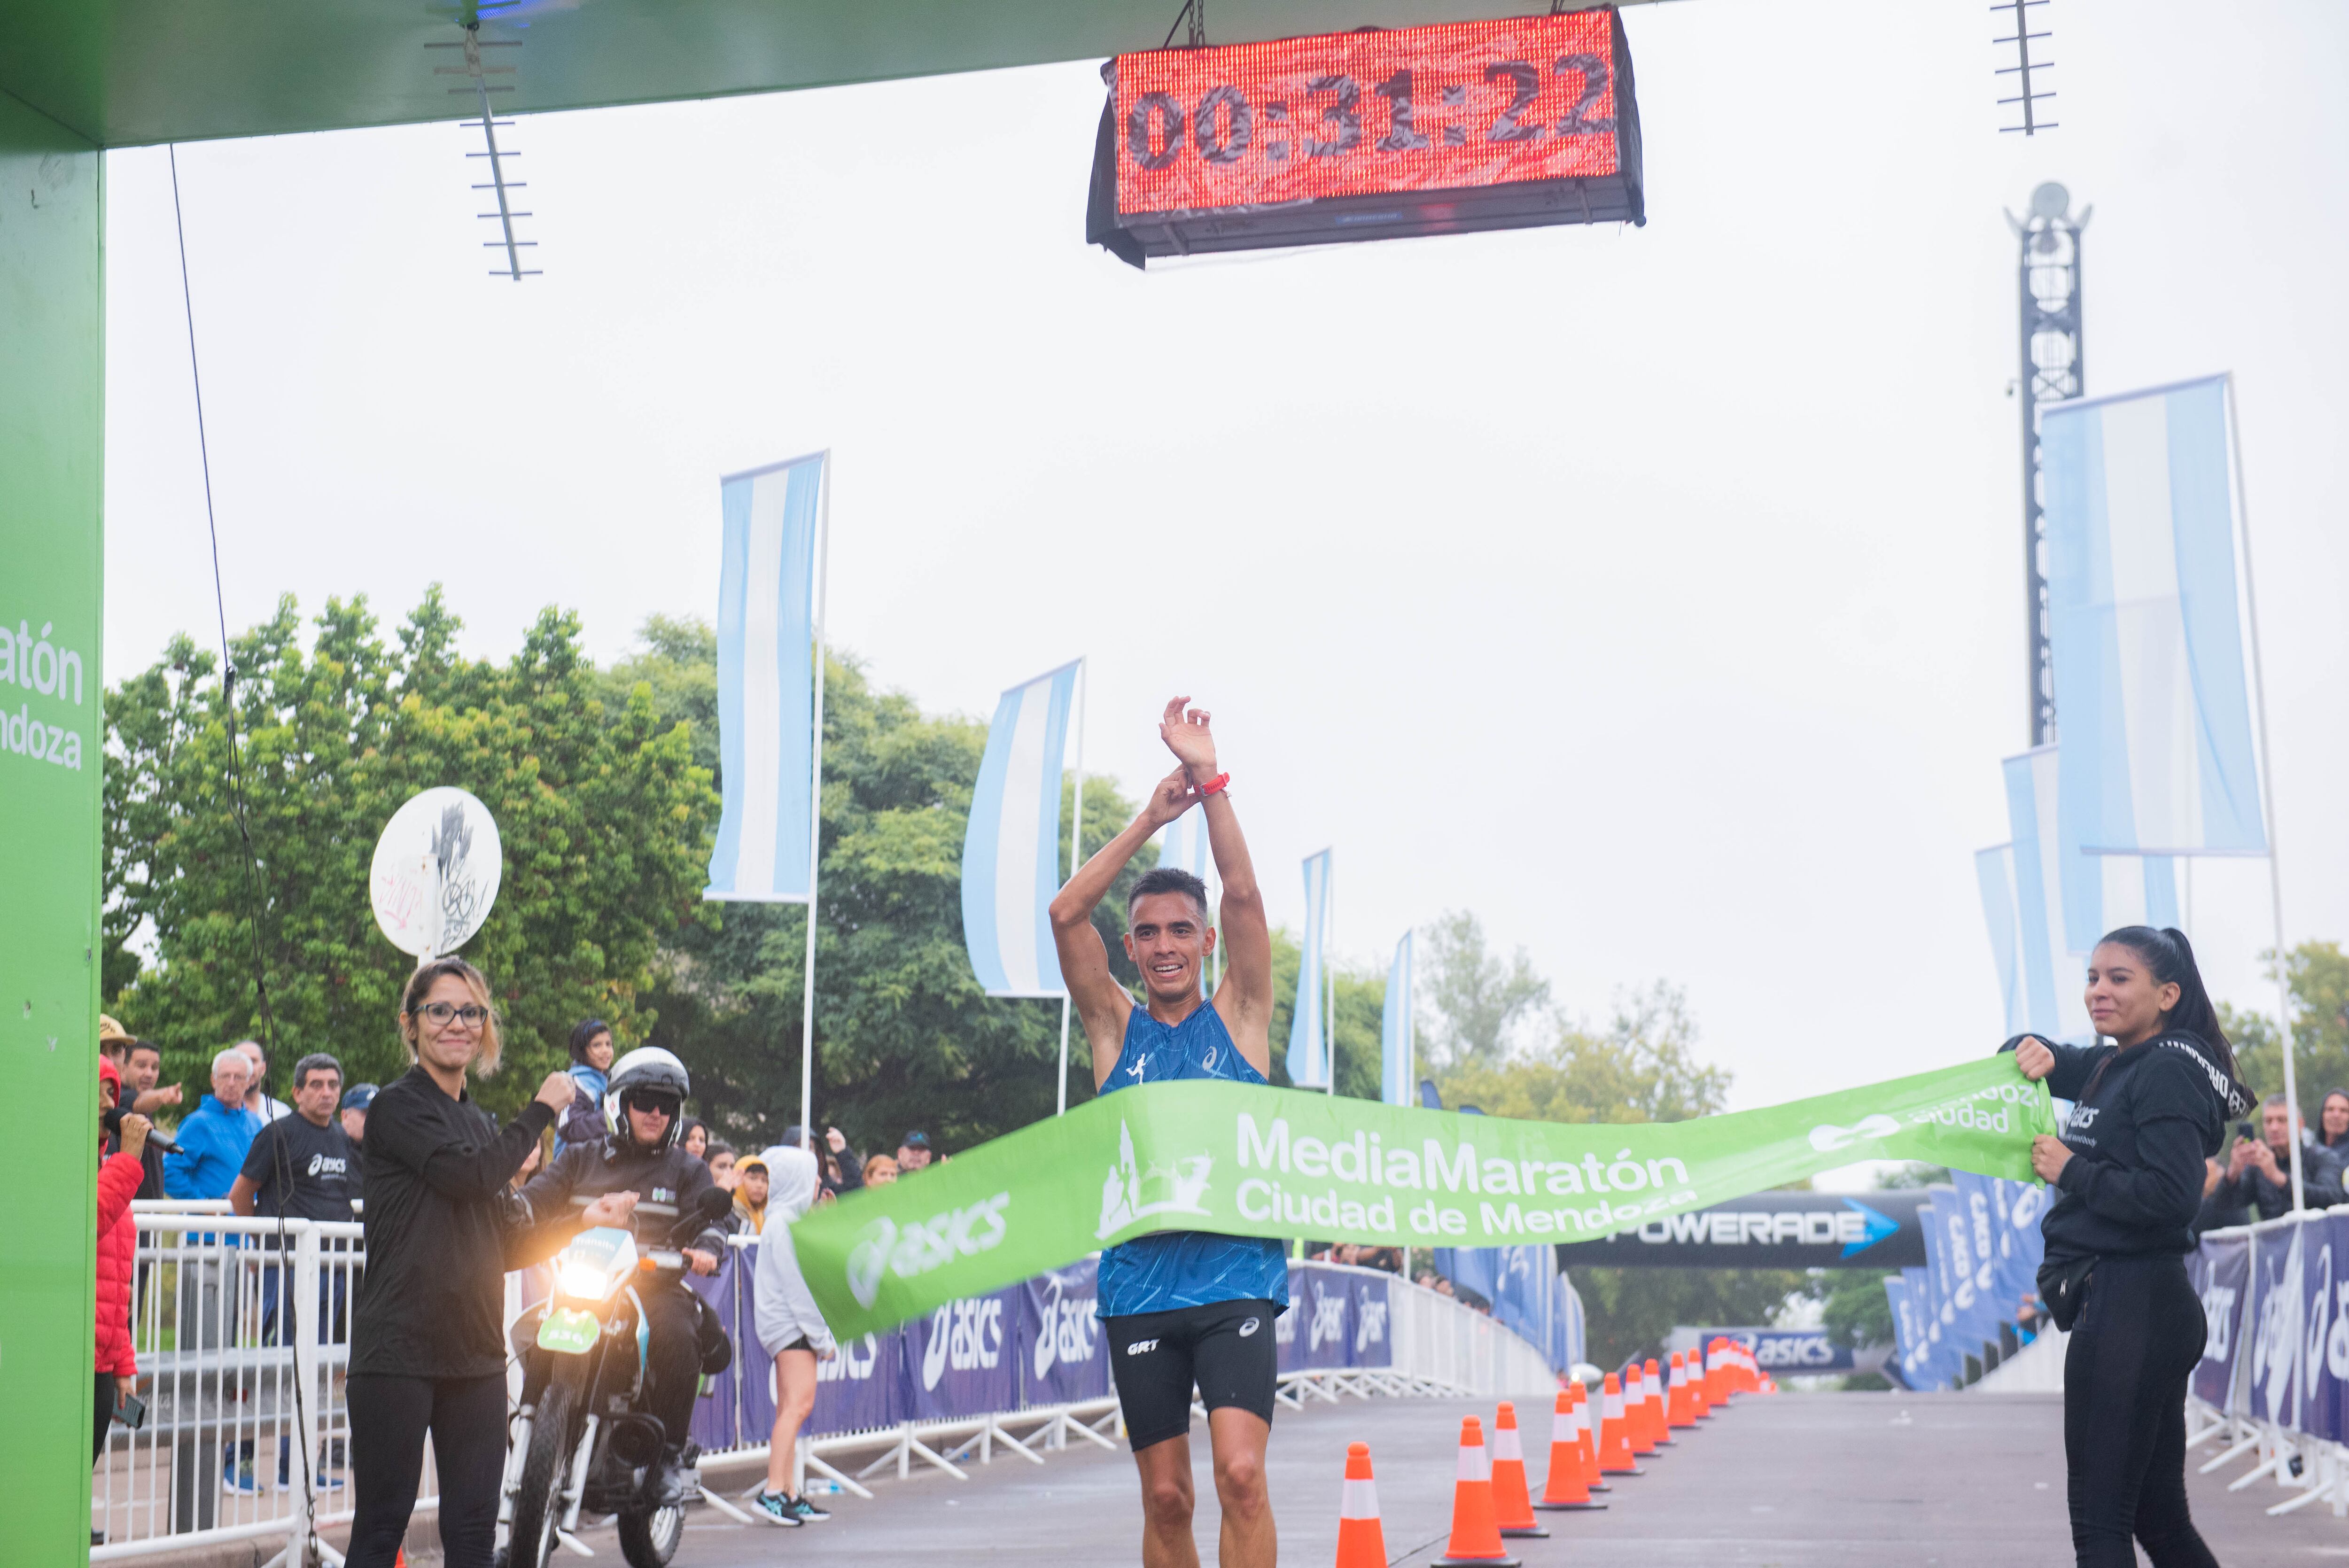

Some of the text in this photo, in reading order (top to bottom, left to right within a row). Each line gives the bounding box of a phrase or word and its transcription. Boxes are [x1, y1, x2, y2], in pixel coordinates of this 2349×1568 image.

[1128, 53, 1617, 170] 00:31:22
[1237, 1112, 1690, 1195] MediaMaratón
[890, 1190, 1011, 1279] asics
[1236, 1178, 1698, 1236] Ciudad de Mendoza
[1606, 1211, 1865, 1245] OWERADE
[950, 1298, 1002, 1371] asics
[1058, 1298, 1098, 1363] asics
[1127, 1338, 1160, 1356] GRT
[1756, 1337, 1834, 1366] asics
